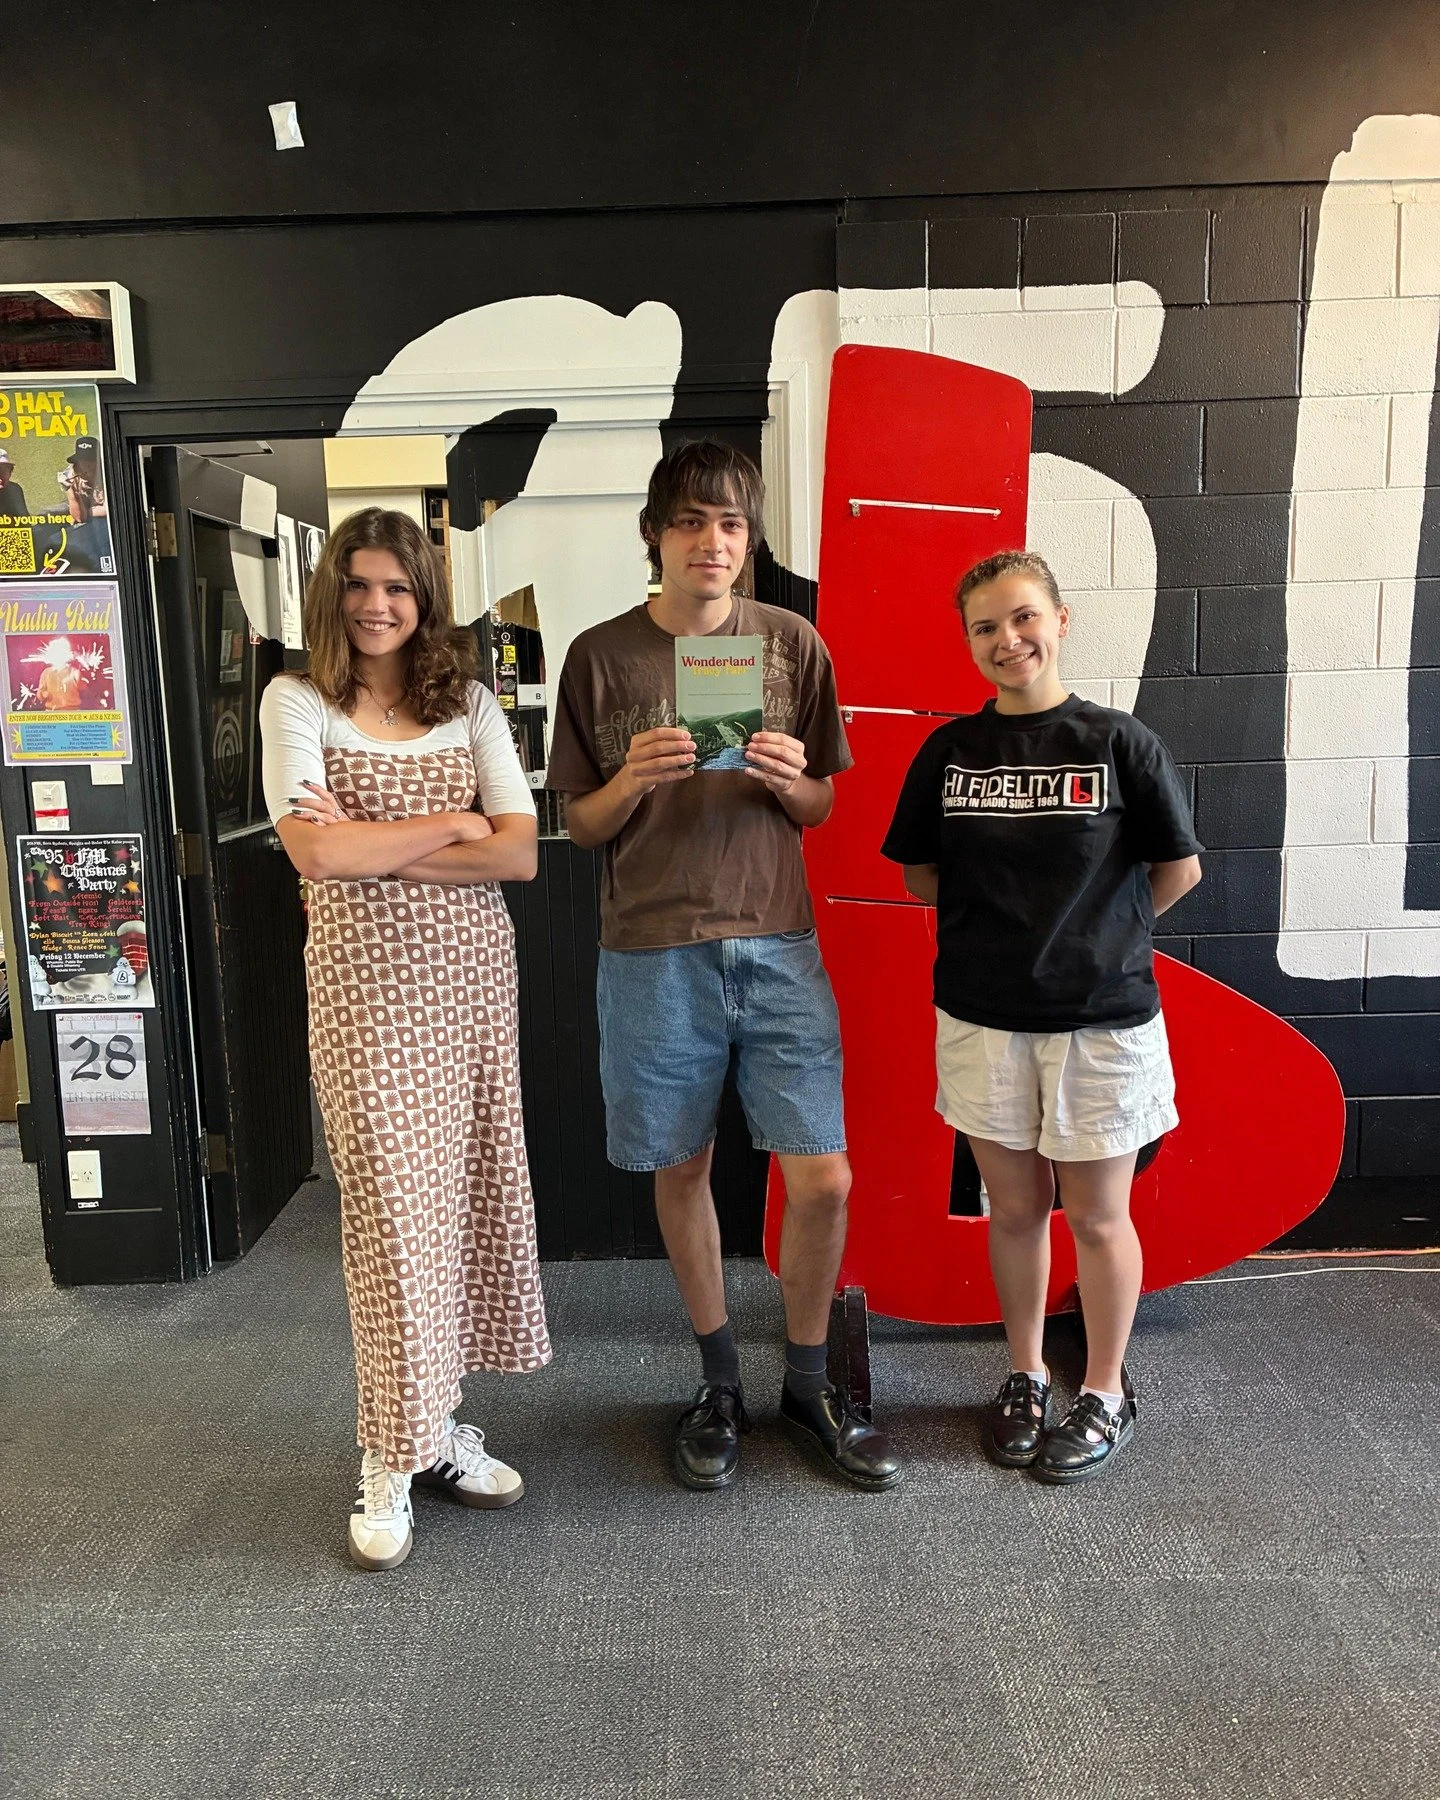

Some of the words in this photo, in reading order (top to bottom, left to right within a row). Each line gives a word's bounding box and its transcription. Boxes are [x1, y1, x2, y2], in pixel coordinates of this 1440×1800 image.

[15, 391, 73, 416] HAT,
[18, 413, 88, 437] PLAY!
[15, 515, 45, 526] yours
[0, 601, 58, 632] Nadia
[66, 600, 112, 631] Reid
[681, 655, 756, 668] Wonderland
[945, 773, 964, 796] HI
[968, 773, 1061, 798] FIDELITY
[968, 797, 980, 808] IN
[981, 797, 1007, 808] RADIO
[1008, 798, 1034, 809] SINCE
[1037, 796, 1058, 807] 1969
[60, 863, 127, 880] Christmas
[77, 877, 117, 893] Party
[40, 953, 62, 961] Friday
[74, 952, 105, 960] December
[70, 1035, 136, 1081] 28
[66, 1092, 83, 1102] IN
